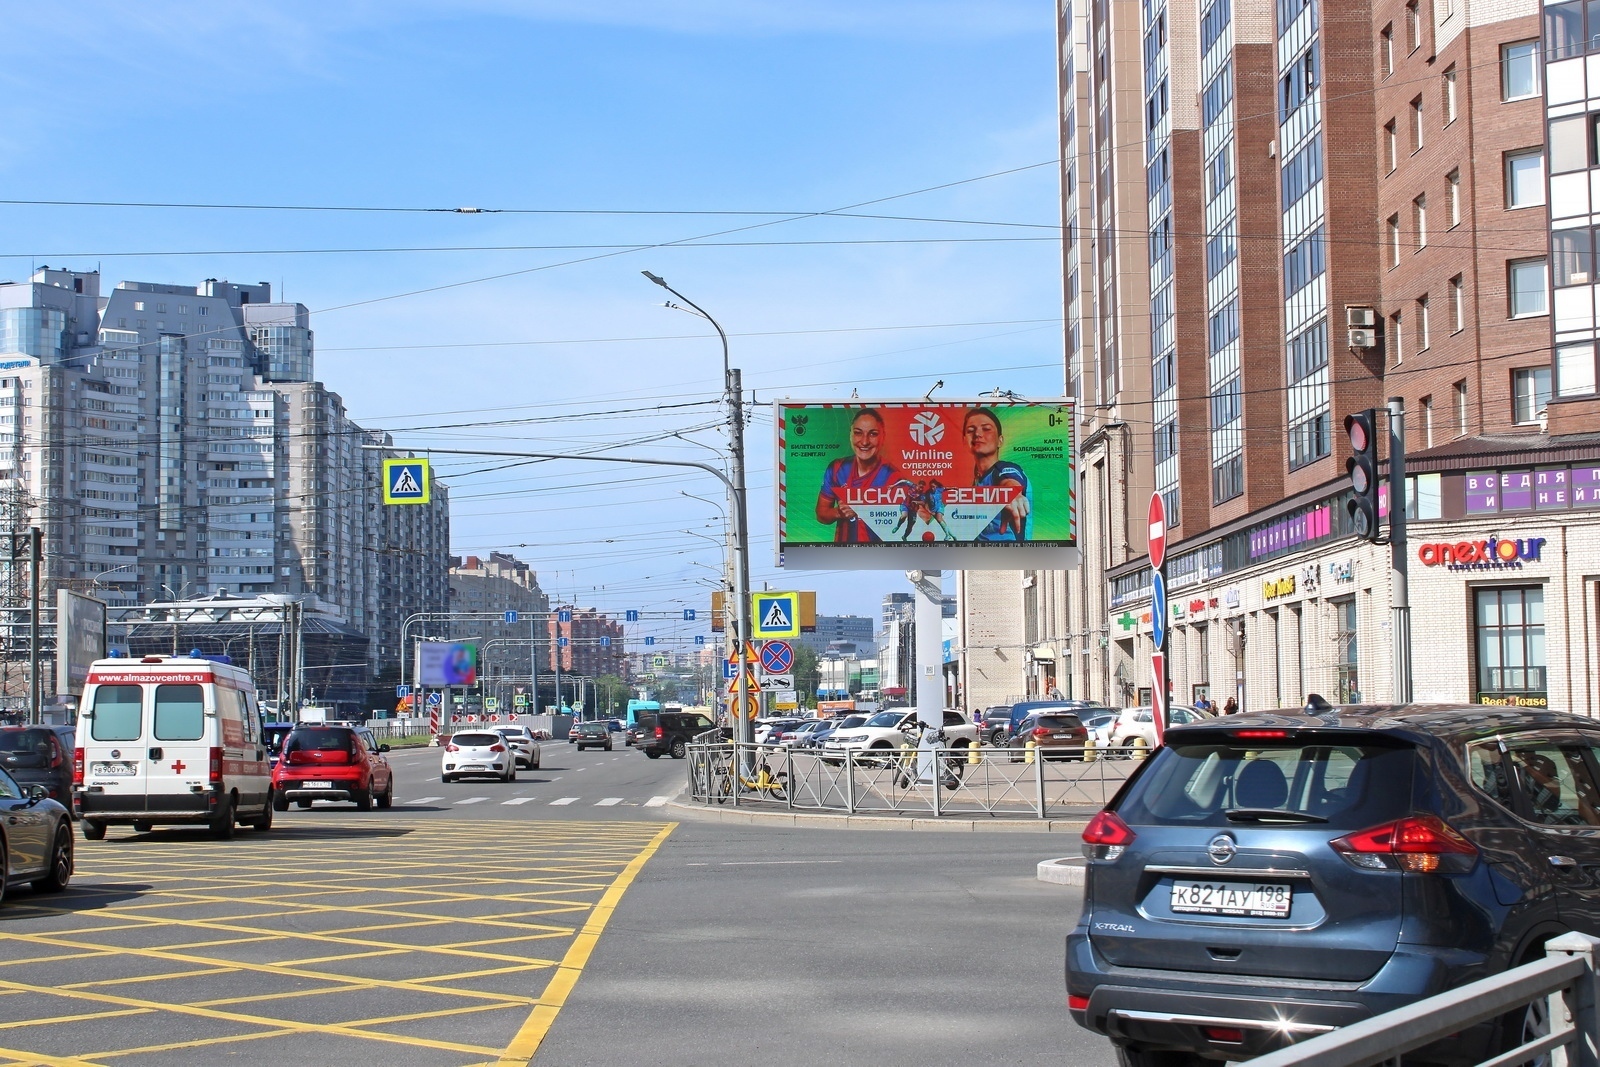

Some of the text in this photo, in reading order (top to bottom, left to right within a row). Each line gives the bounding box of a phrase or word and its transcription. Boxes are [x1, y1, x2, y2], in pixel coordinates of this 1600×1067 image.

[1049, 414, 1063, 427] 0+
[902, 449, 953, 460] Winline
[902, 462, 953, 470] СУПЕРКУБОК
[1469, 474, 1509, 489] ВСЁ
[1520, 472, 1565, 488] ДЛЯ
[846, 487, 1013, 505] ЦСКА ЗЕНИТ
[1252, 521, 1306, 552] КОВОРКИНГ
[1418, 537, 1545, 565] anextour
[97, 672, 205, 683] www.almazovcentre.ru
[1177, 884, 1284, 907] К821АУ 198
[1094, 922, 1136, 933] X-TRAIL
